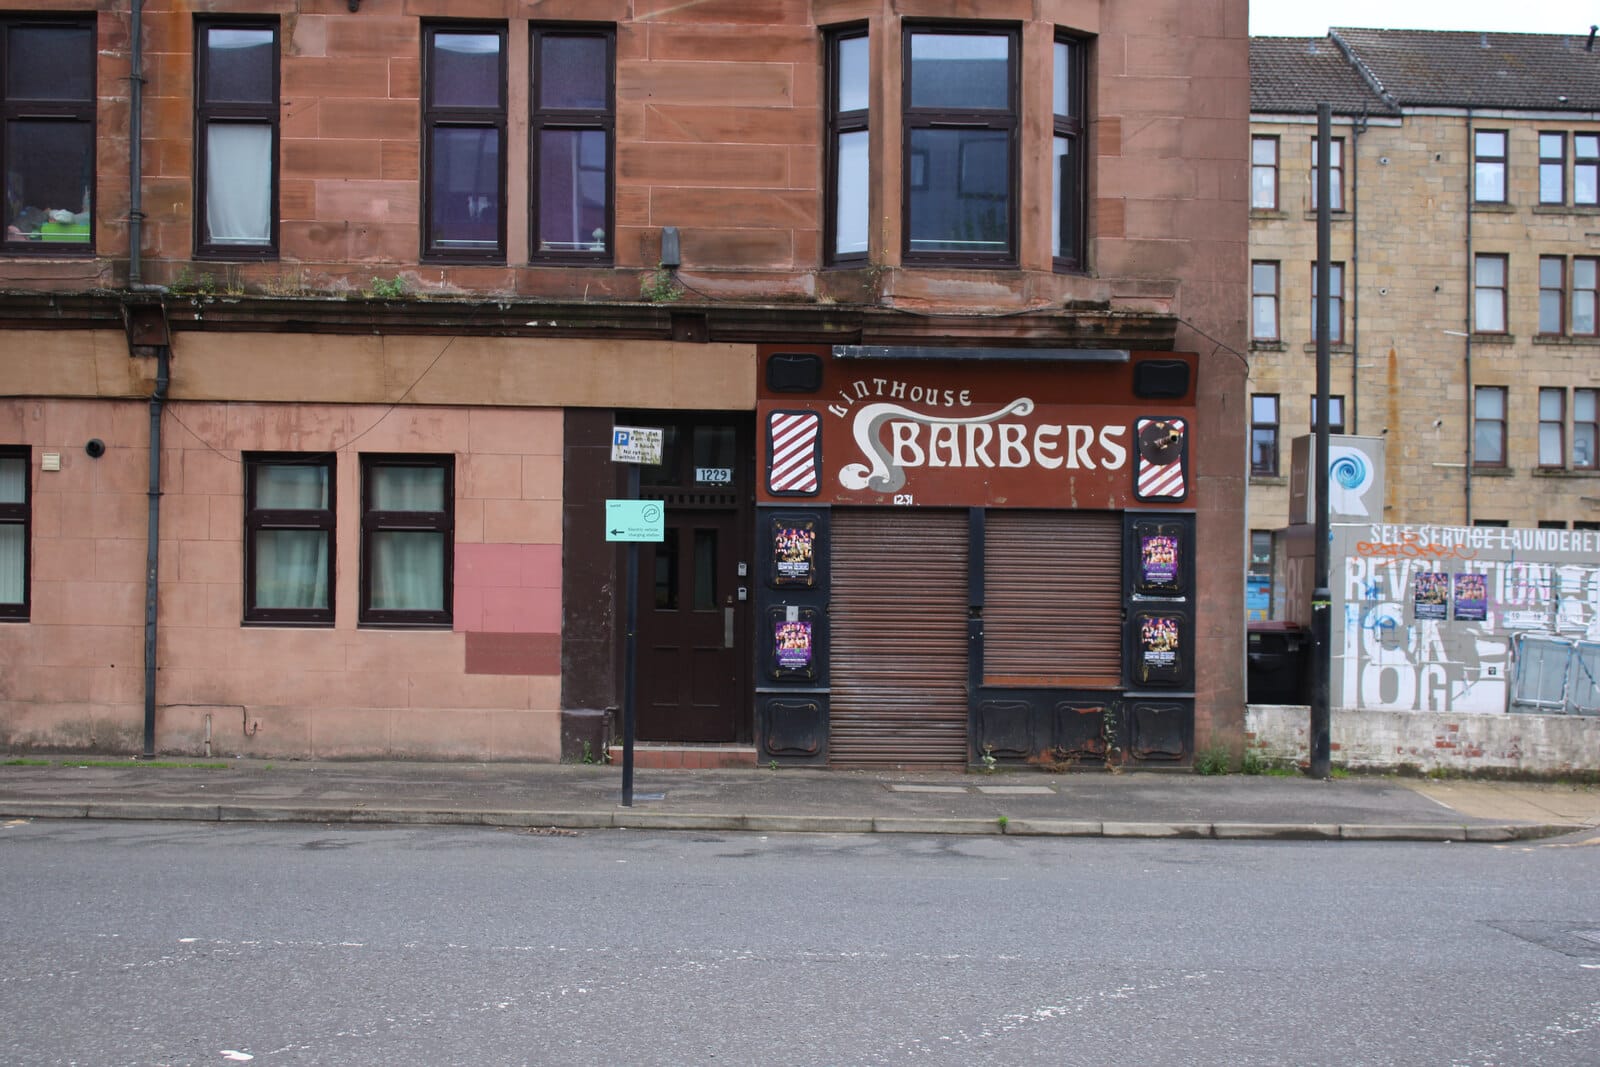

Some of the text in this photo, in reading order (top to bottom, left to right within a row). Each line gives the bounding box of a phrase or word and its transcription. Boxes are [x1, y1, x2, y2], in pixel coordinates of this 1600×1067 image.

[618, 433, 627, 445] P
[891, 421, 1127, 470] BARBERS
[701, 469, 727, 481] 1229
[894, 494, 913, 505] 1231
[1370, 524, 1413, 545] SELF
[1419, 525, 1494, 549] SERVICE
